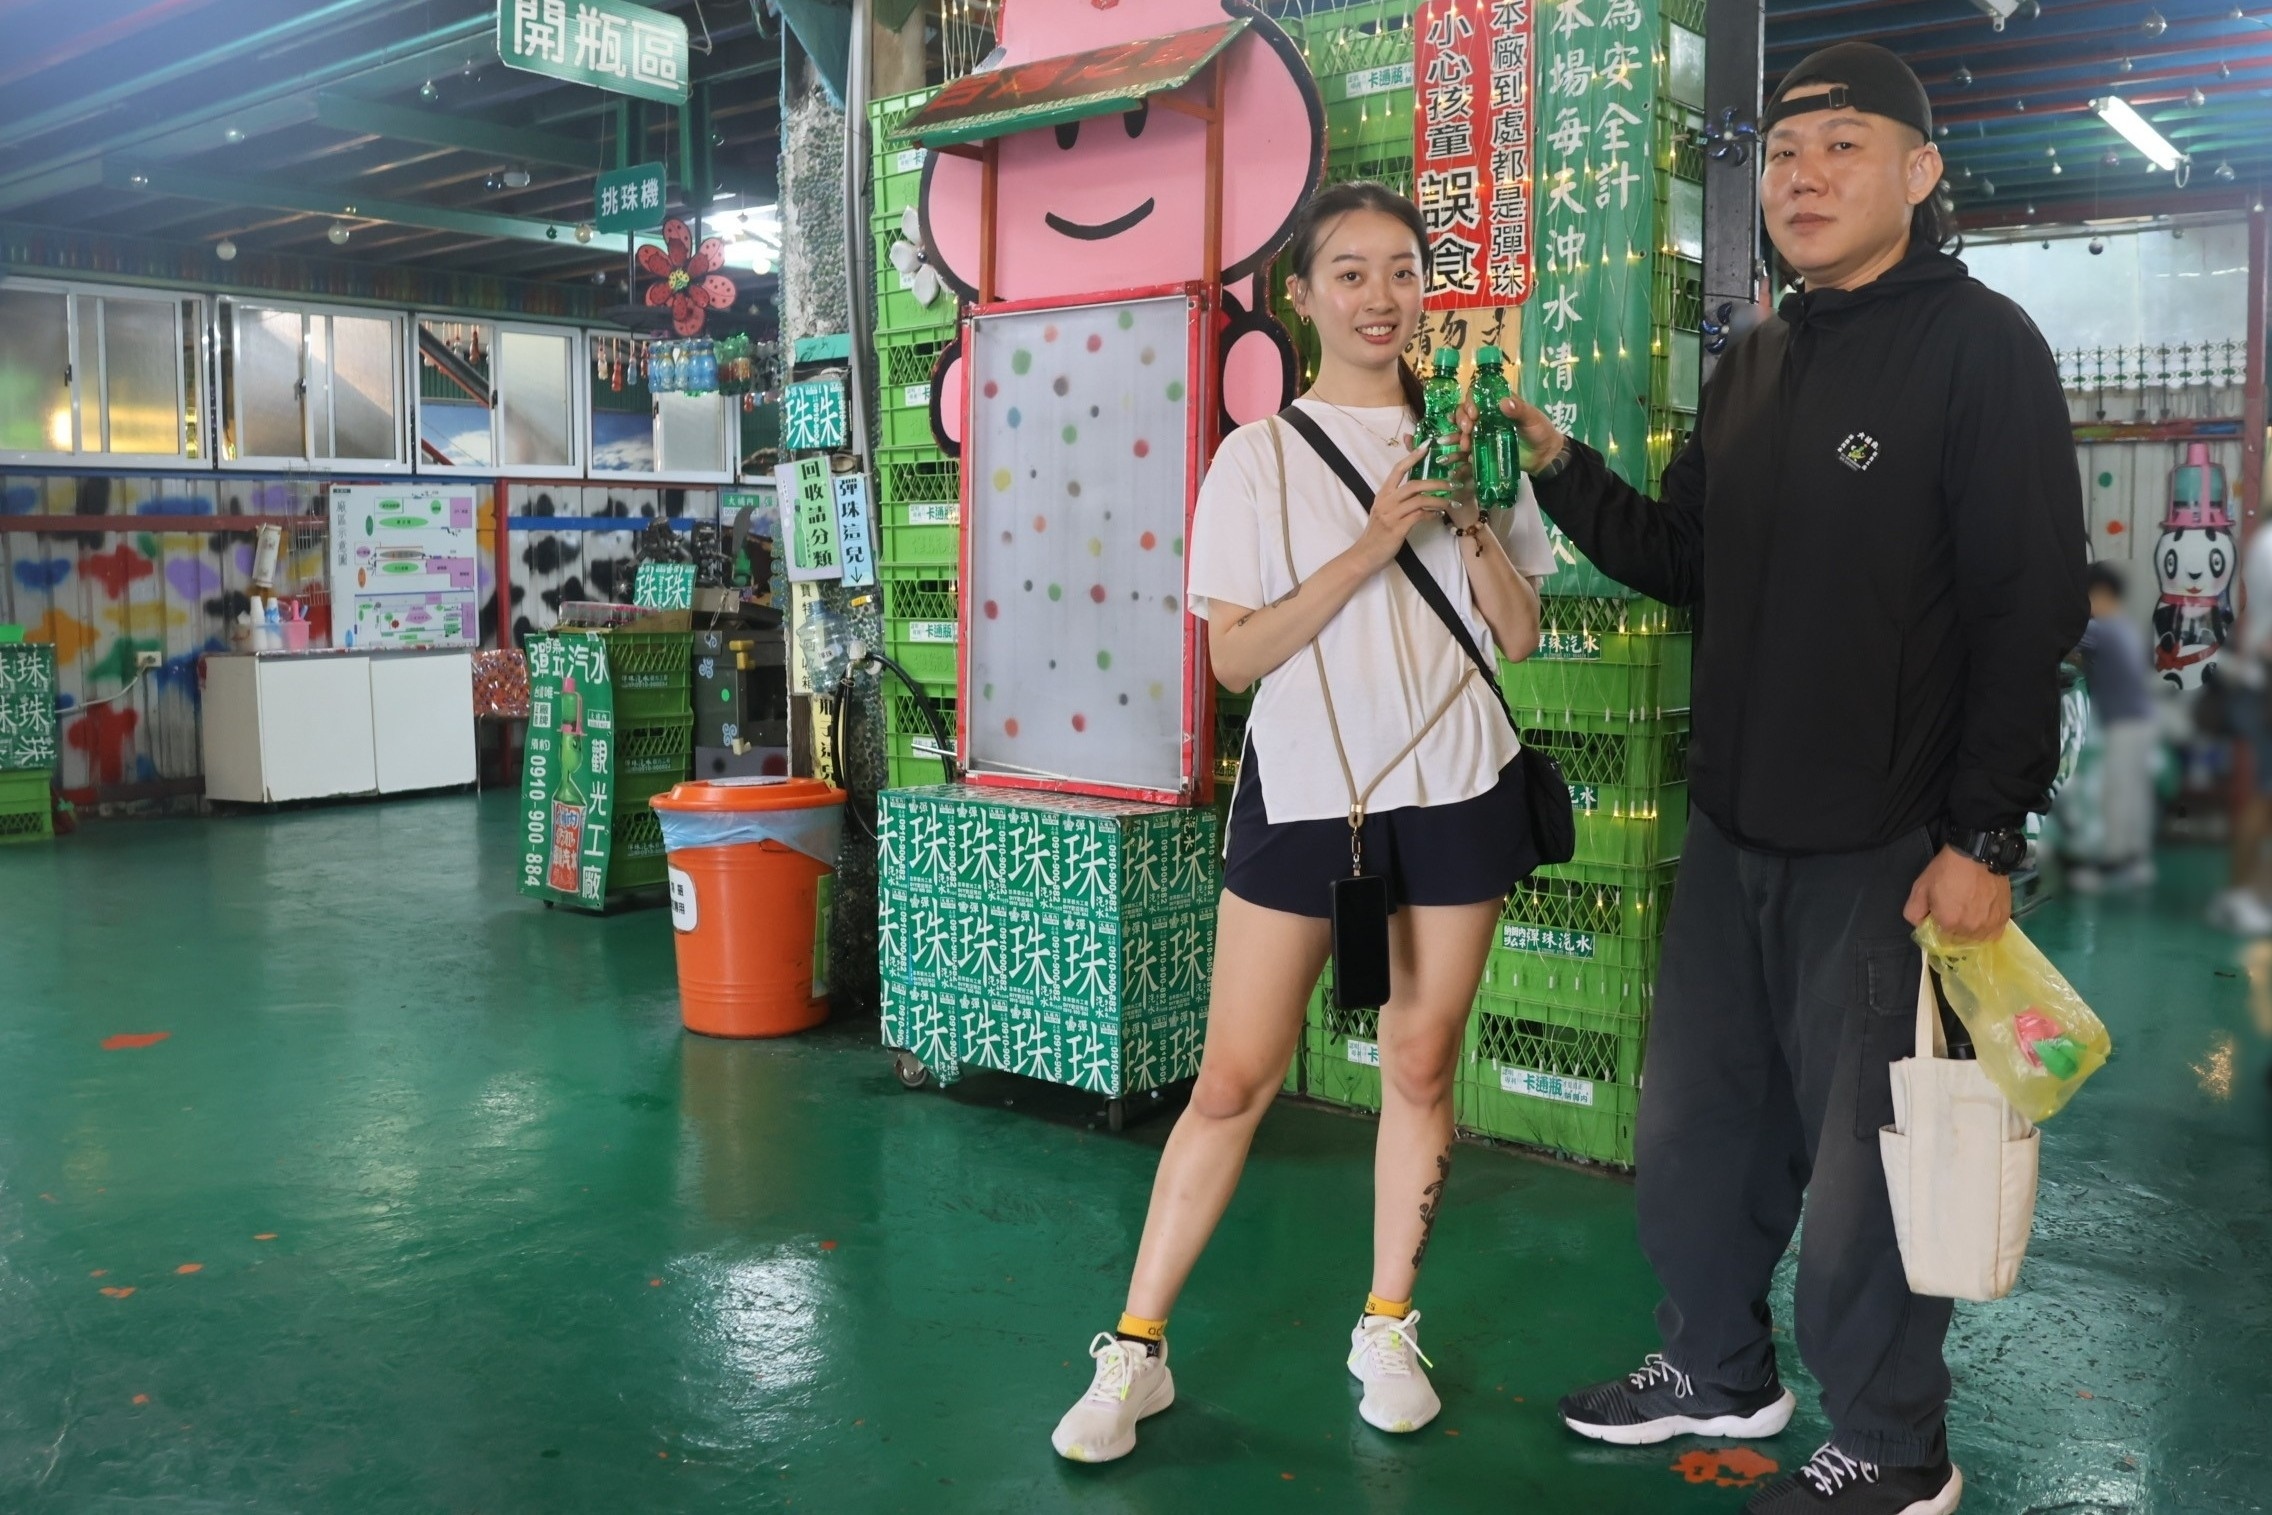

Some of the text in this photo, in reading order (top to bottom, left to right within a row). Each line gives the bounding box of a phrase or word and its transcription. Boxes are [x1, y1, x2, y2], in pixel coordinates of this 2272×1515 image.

[514, 0, 679, 90] 開瓶區
[1368, 66, 1403, 89] 卡通瓶
[1595, 0, 1642, 210] 為安全計
[1490, 0, 1527, 297] 本廠到處都是彈珠
[601, 177, 659, 216] 挑珠機
[801, 461, 832, 568] 回收請分類
[840, 478, 864, 564] 彈珠這兒
[524, 755, 546, 887] 0910-900-884
[582, 739, 608, 900] 觀光工廠
[909, 802, 951, 886] 珠
[958, 807, 1000, 893] 珠
[1008, 812, 1054, 900] 珠
[1062, 820, 1110, 910] 珠
[1121, 820, 1160, 908] 珠
[911, 897, 954, 980] 珠
[958, 903, 1002, 988] 珠
[1008, 912, 1055, 998] 珠
[1063, 920, 1110, 1009] 珠
[1122, 922, 1160, 1010] 珠
[1169, 913, 1206, 998] 珠
[1526, 927, 1593, 953] 彈珠汽水
[910, 992, 953, 1073] 珠
[961, 999, 1005, 1070] 珠
[1011, 1010, 1058, 1082] 珠
[1066, 1021, 1115, 1095] 珠
[1124, 1022, 1158, 1093] 珠
[1523, 1073, 1563, 1097] 卡通瓶
